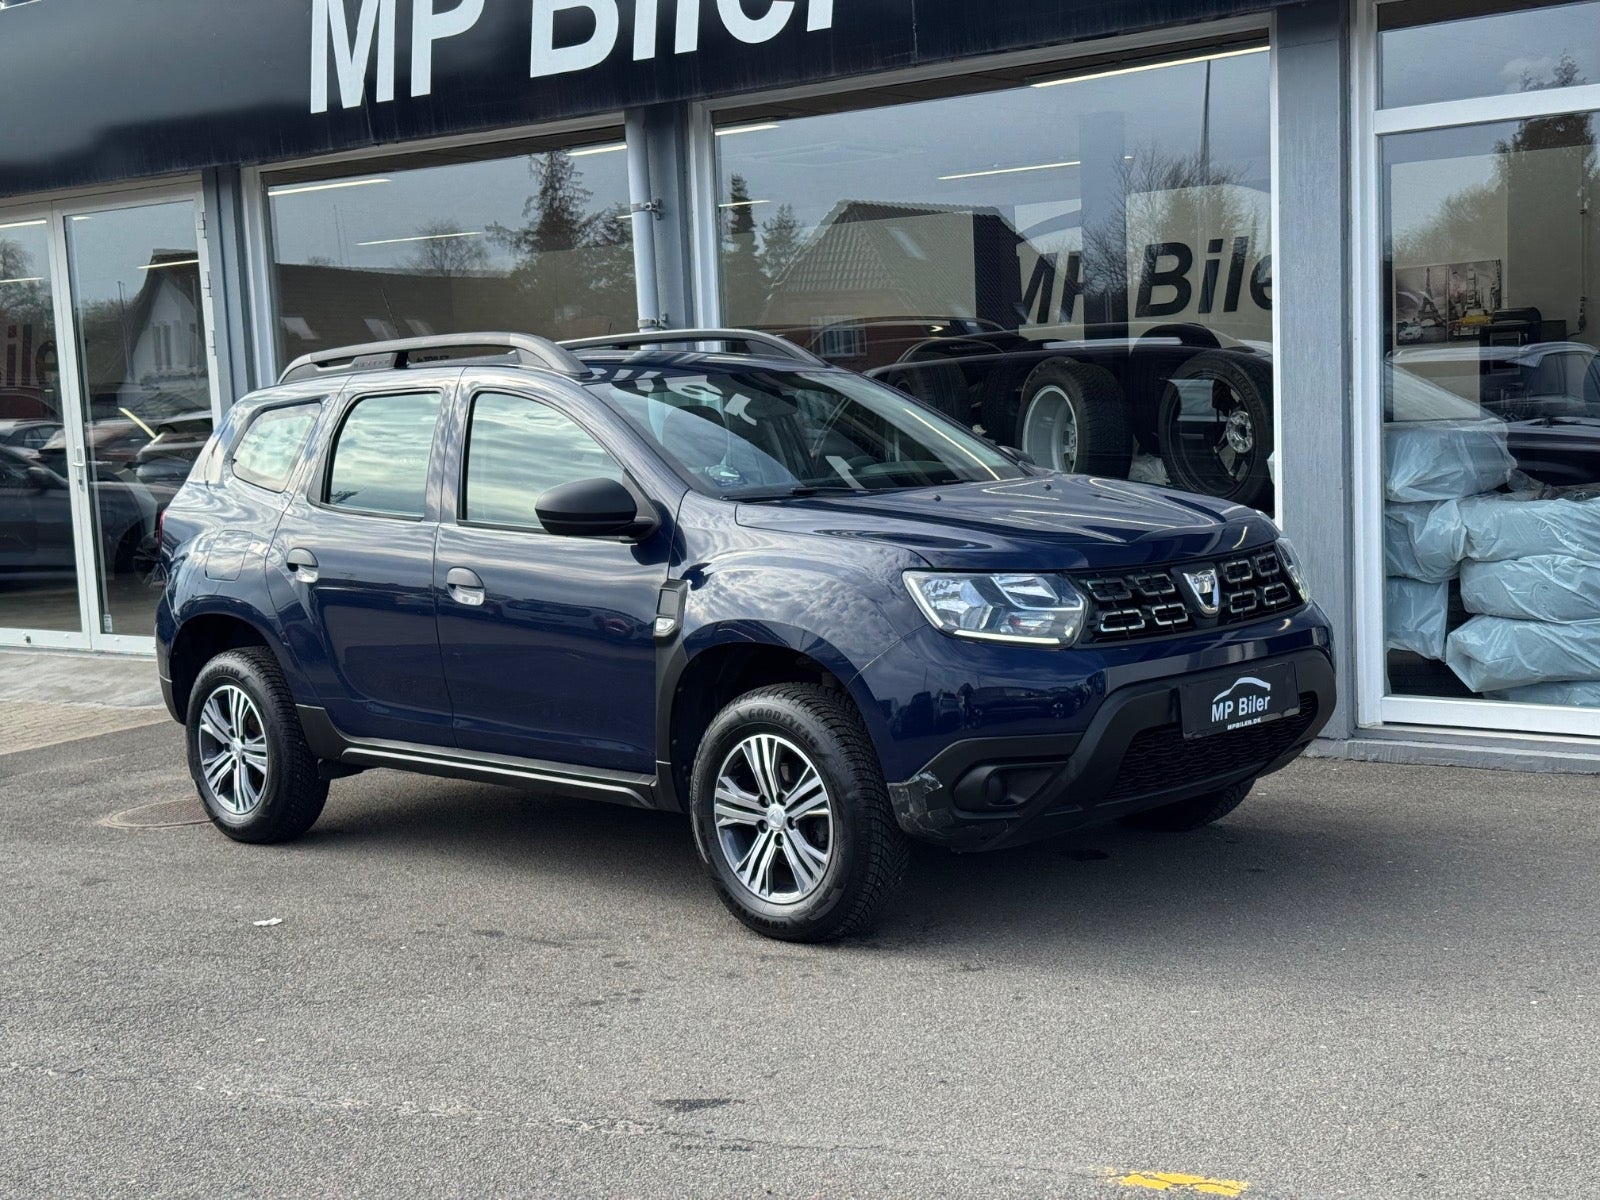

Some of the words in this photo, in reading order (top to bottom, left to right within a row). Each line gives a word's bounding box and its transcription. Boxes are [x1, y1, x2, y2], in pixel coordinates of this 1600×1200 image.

[310, 0, 483, 114] MP
[0, 324, 60, 387] ile
[1211, 700, 1234, 722] MP
[1238, 694, 1270, 716] Biler
[1227, 717, 1262, 730] MPBILER.DK
